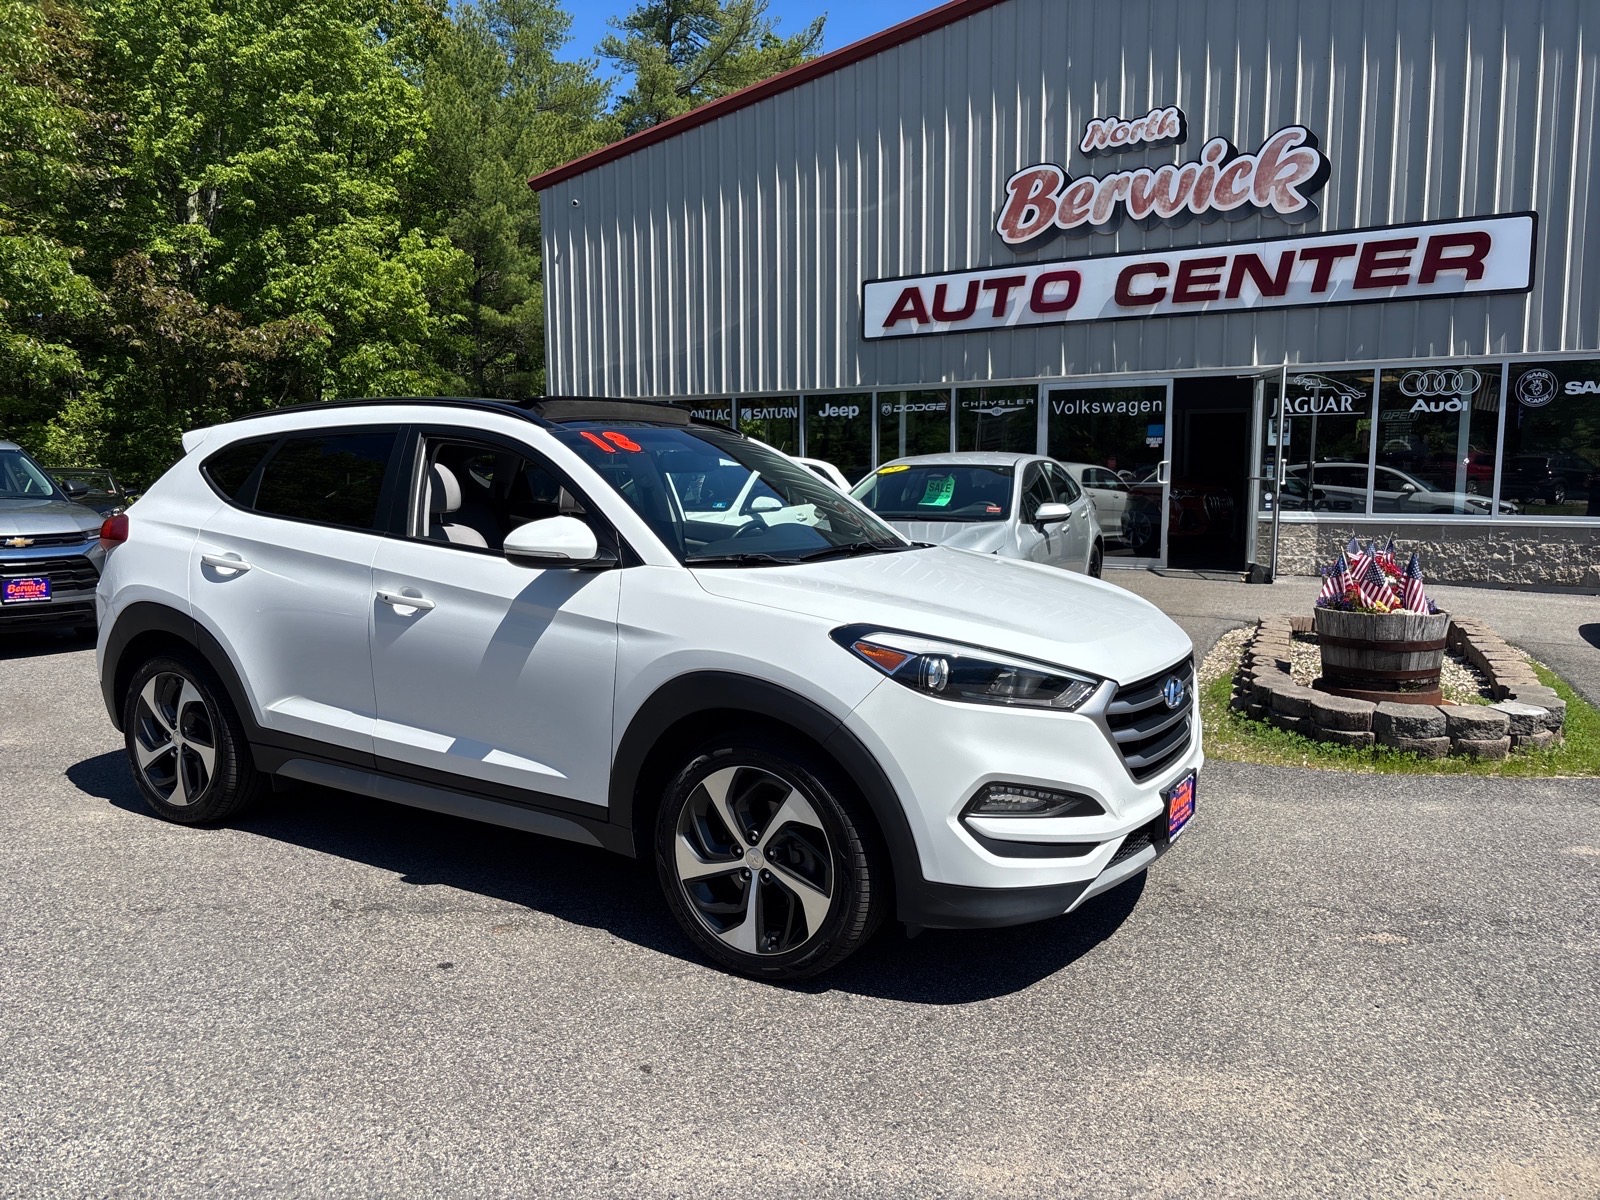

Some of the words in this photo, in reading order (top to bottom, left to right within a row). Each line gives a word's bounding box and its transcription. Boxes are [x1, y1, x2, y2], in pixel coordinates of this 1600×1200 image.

[1083, 108, 1179, 153] North
[999, 126, 1320, 244] Berwick
[882, 270, 1083, 329] AUTO
[1113, 231, 1492, 308] CENTER
[1526, 371, 1549, 381] SAAB
[961, 398, 1034, 408] CHRYSLER
[1409, 398, 1468, 413] Audi
[1524, 394, 1550, 404] SCANIA
[818, 403, 860, 419] Jeep
[893, 402, 948, 413] DODGE
[1052, 399, 1163, 416] Volkswagen
[1270, 395, 1354, 418] JAGUAR
[689, 408, 731, 420] ONTIAC
[753, 407, 798, 420] SATURN
[1381, 410, 1418, 420] OPEN
[579, 431, 642, 453] 18
[928, 482, 952, 493] SALE
[7, 582, 47, 594] Berwick
